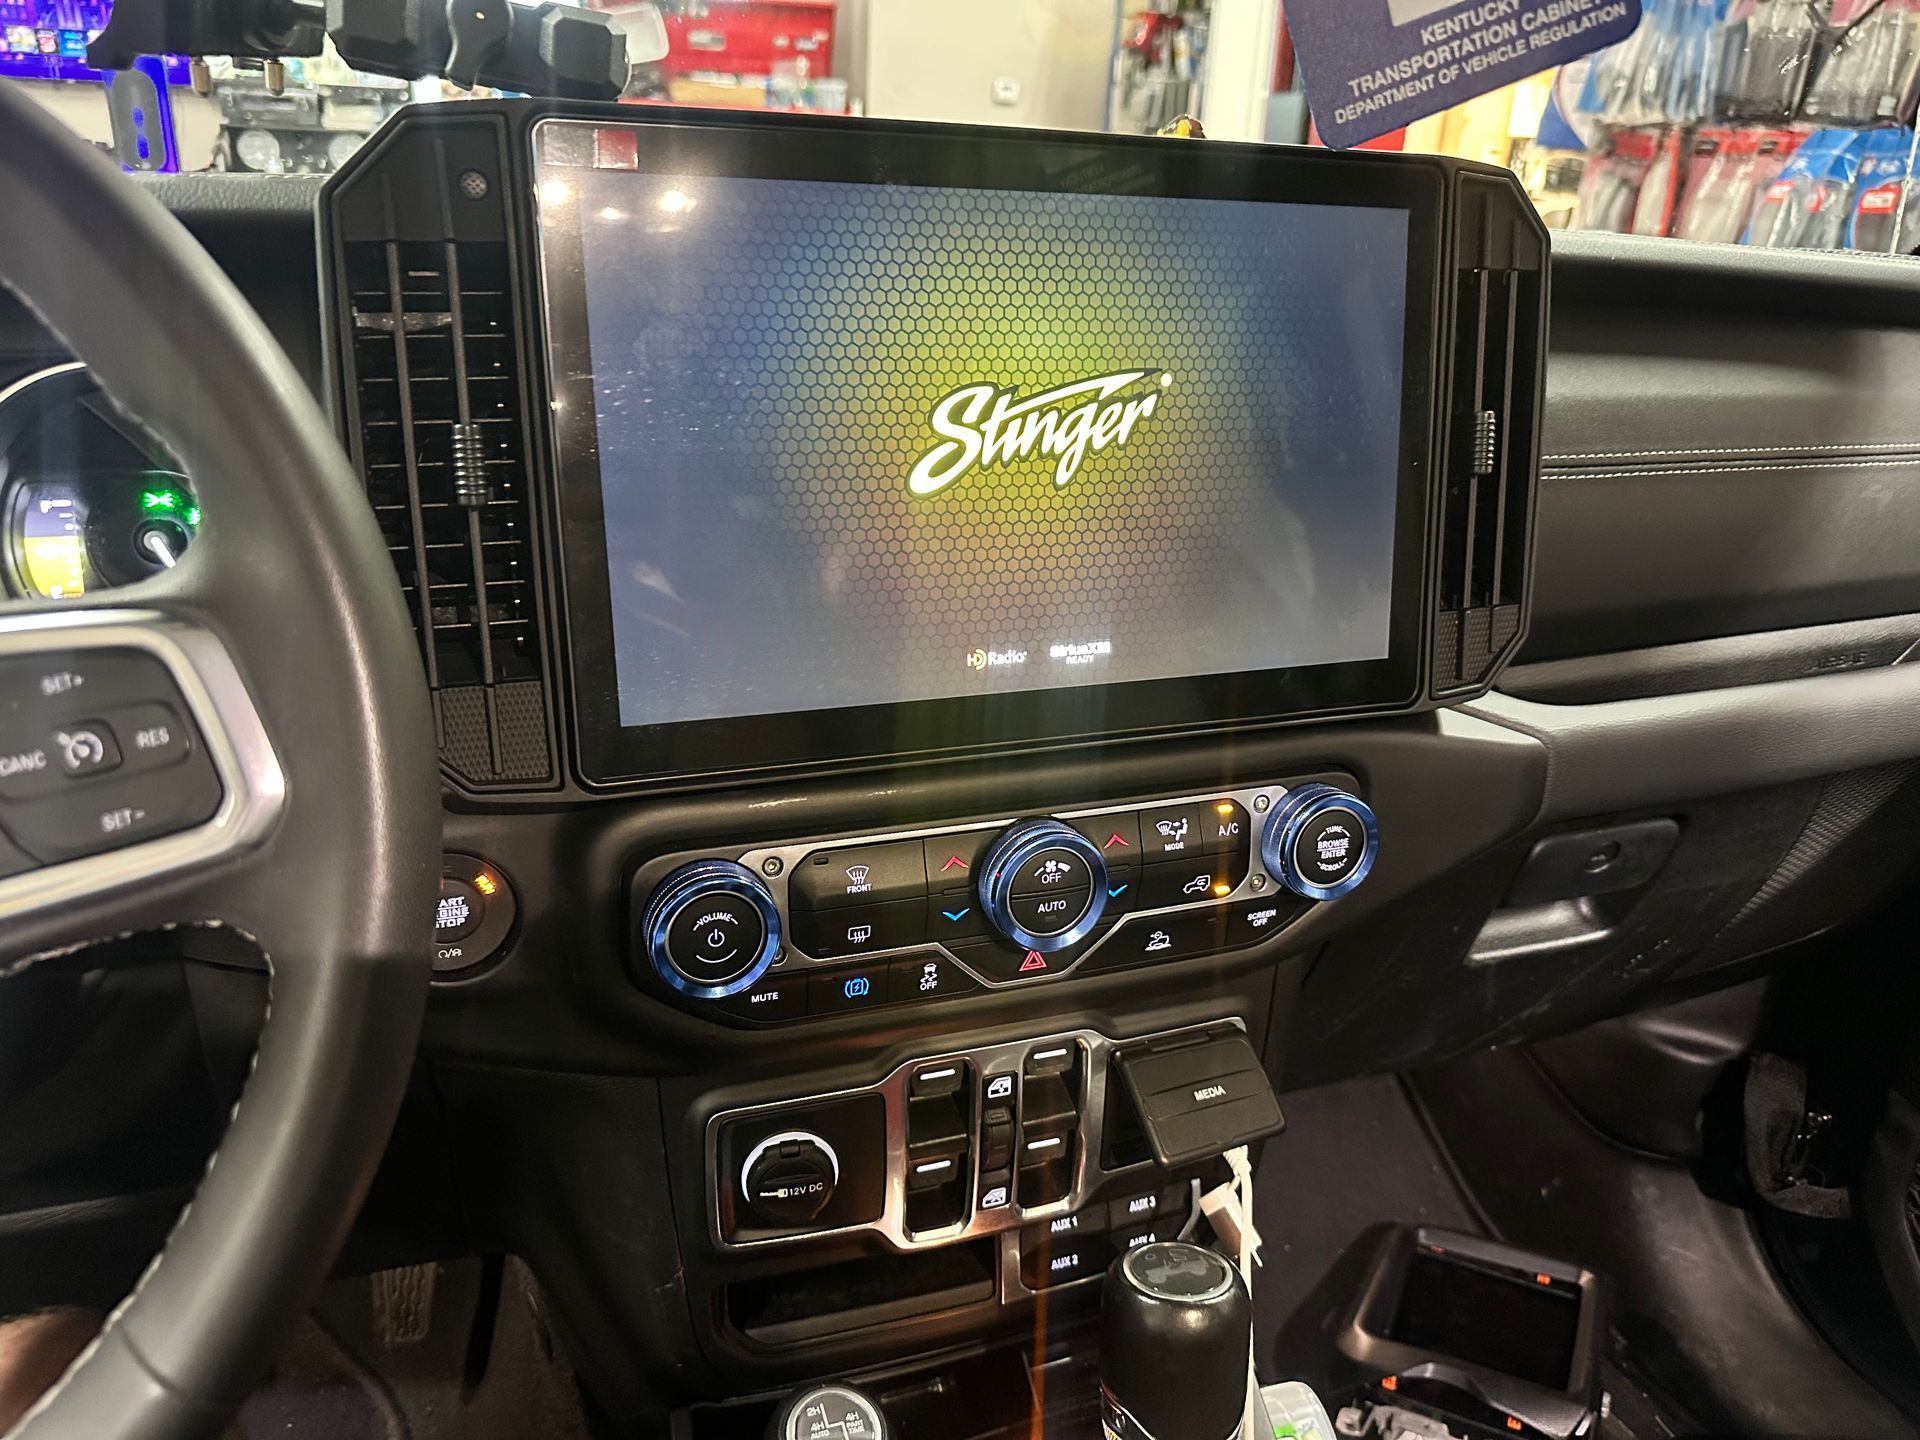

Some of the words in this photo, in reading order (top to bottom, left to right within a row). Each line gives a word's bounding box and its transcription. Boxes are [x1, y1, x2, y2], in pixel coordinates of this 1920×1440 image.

[1421, 0, 1521, 46] KENTUCKY
[1334, 73, 1436, 125] DEPARTMENT
[1437, 65, 1461, 84] OF
[1462, 39, 1527, 75] VEHICLE
[1529, 2, 1628, 51] REGULATION
[1348, 21, 1518, 98] TRANSPORTATION
[907, 370, 1163, 496] Stinger
[987, 649, 1025, 666] Radio
[135, 726, 170, 749] RES
[1218, 821, 1239, 837] A/C
[1164, 841, 1185, 852] MODE
[1316, 837, 1350, 850] BROWSE
[1320, 848, 1346, 860] ENTER
[1041, 872, 1063, 886] OFF
[846, 883, 872, 894] FRONT
[1037, 899, 1067, 915] AUTO
[697, 911, 734, 926] VOLUME
[1247, 908, 1277, 922] SCREEN
[1253, 917, 1269, 928] OFF
[919, 980, 938, 991] OFF
[750, 991, 780, 1004] MUTE
[1193, 1084, 1227, 1102] MEDIA
[789, 1185, 808, 1197] 12V
[808, 1182, 824, 1193] DC
[1128, 1199, 1149, 1213] AUX
[1149, 1195, 1156, 1207] 3
[1050, 1218, 1072, 1233] AUX
[1072, 1215, 1078, 1227] 1
[1050, 1257, 1073, 1271] AUX
[806, 1406, 821, 1417] 2H
[845, 1411, 860, 1421] 4H
[810, 1421, 825, 1432] 4H
[846, 1419, 864, 1429] PART
[810, 1429, 830, 1440] AUTO
